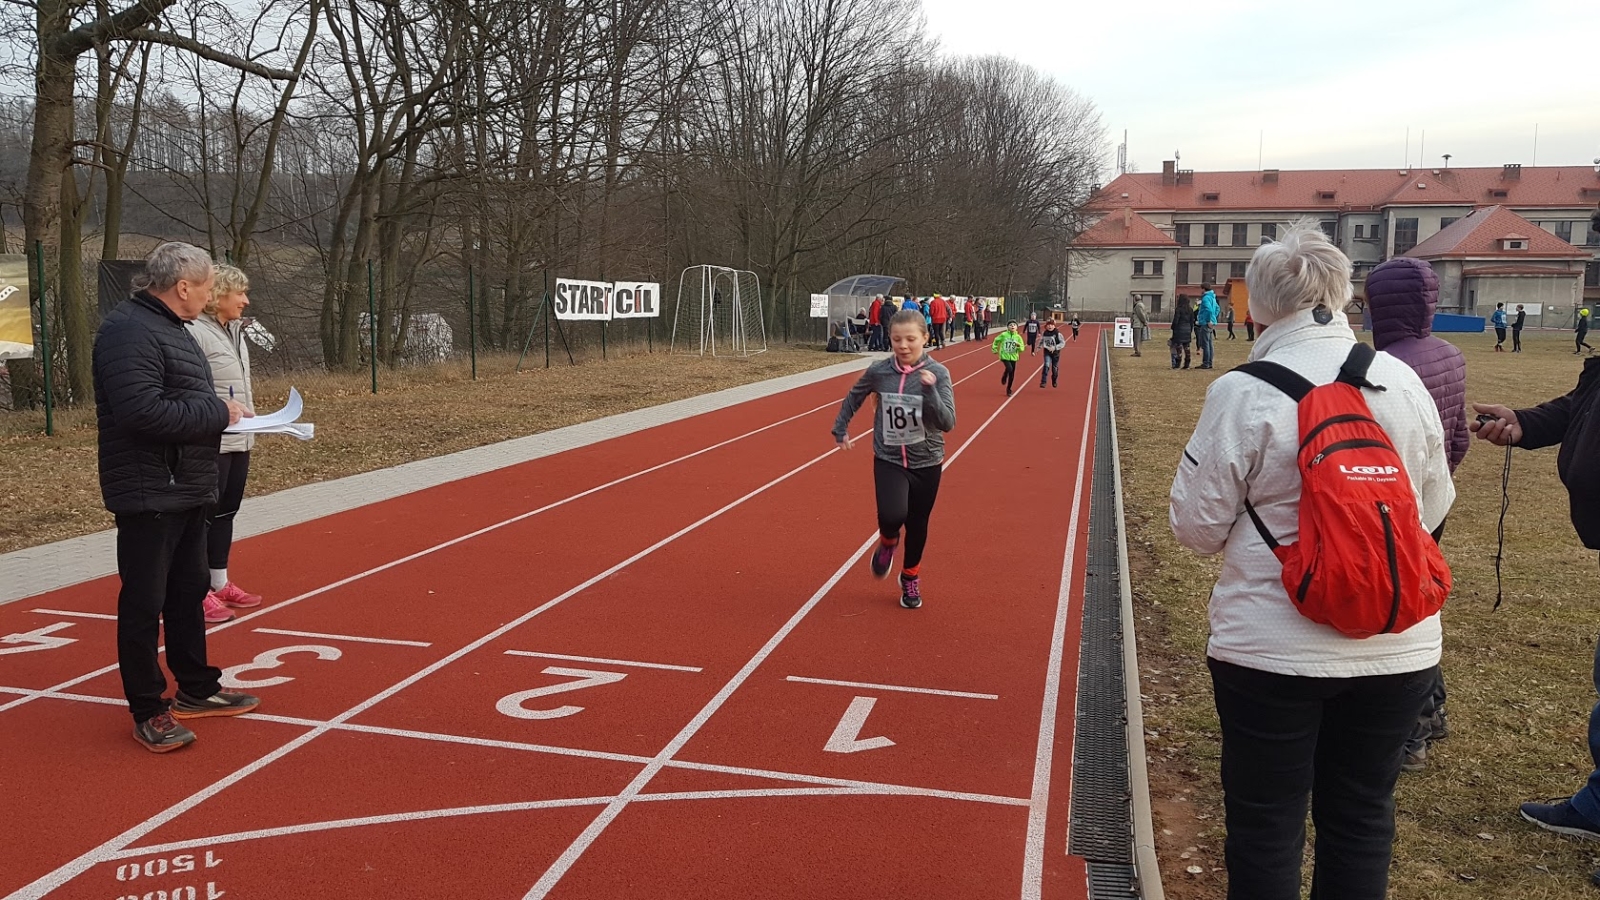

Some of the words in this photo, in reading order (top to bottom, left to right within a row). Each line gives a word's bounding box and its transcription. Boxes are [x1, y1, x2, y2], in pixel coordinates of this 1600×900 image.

[556, 282, 612, 314] START
[615, 285, 654, 314] CÍL
[1005, 341, 1017, 350] 179
[886, 405, 918, 429] 181
[217, 645, 342, 688] 3
[496, 666, 628, 720] 2
[823, 696, 896, 753] 1
[116, 850, 223, 881] 1500
